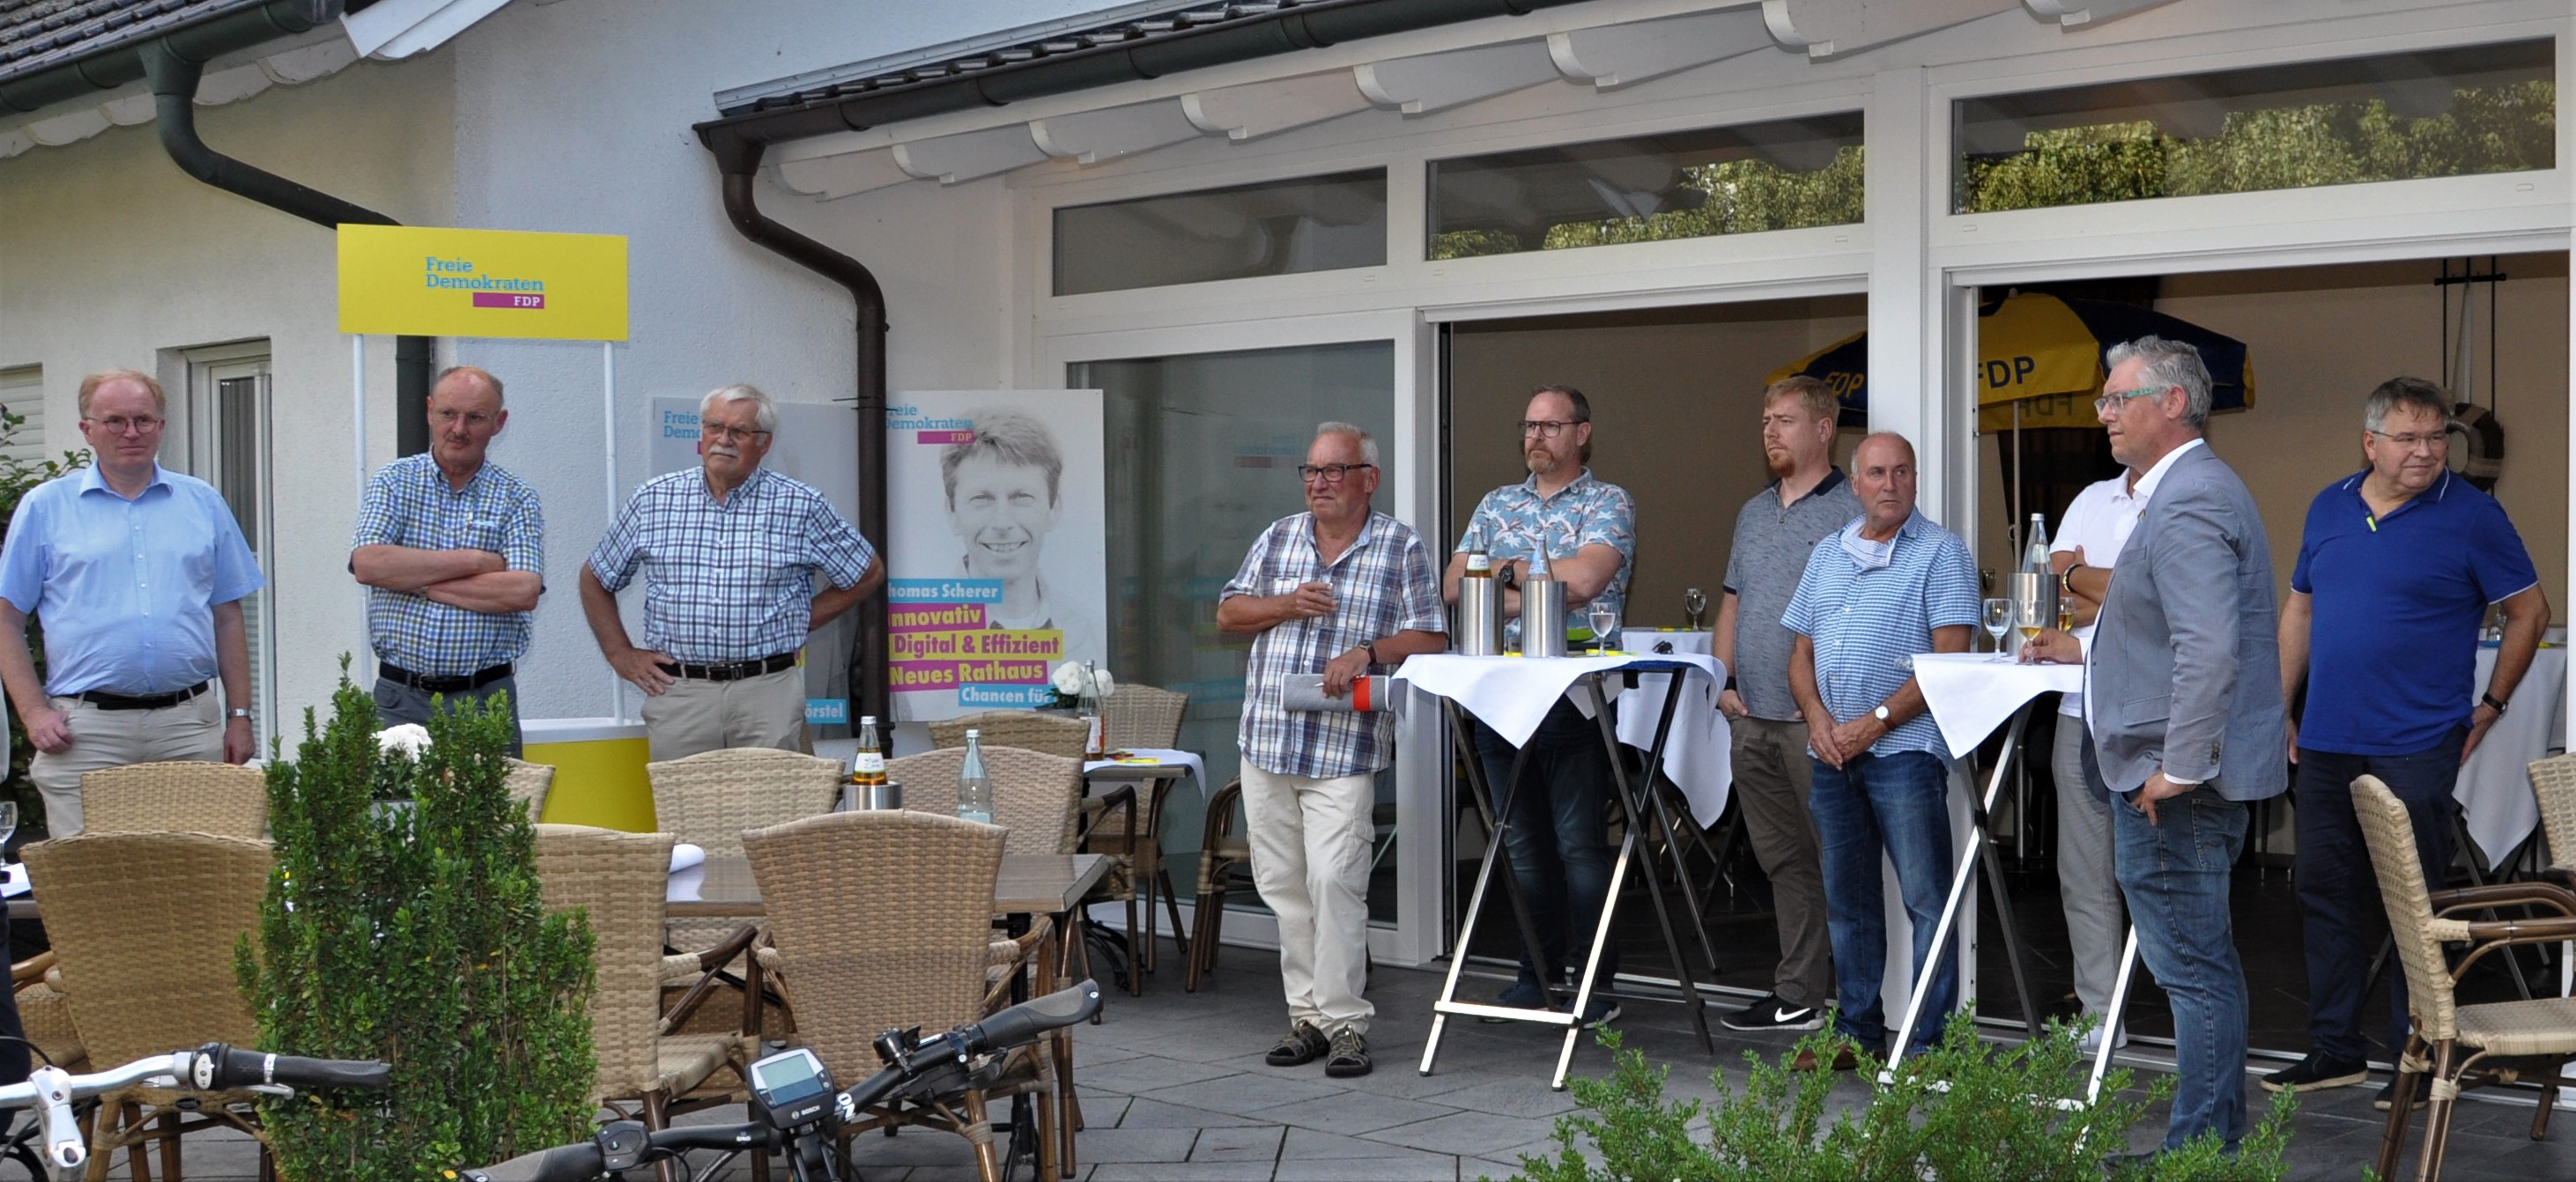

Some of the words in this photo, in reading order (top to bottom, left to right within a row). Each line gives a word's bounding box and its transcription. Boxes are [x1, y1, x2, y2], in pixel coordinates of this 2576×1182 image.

[426, 256, 472, 272] Freie
[426, 274, 544, 291] Demokraten
[514, 296, 540, 306] FDP
[1978, 356, 2035, 389] DP
[663, 410, 699, 424] Freie
[951, 432, 973, 442] FDP
[888, 582, 938, 598] homas
[941, 583, 998, 599] Scherer
[894, 633, 957, 659] Digital
[962, 634, 976, 654] &
[981, 633, 1060, 654] Effizient
[890, 666, 954, 686] Neues
[958, 661, 1044, 683] Rathaus
[961, 687, 1024, 704] Chancen
[804, 702, 844, 719] örstel
